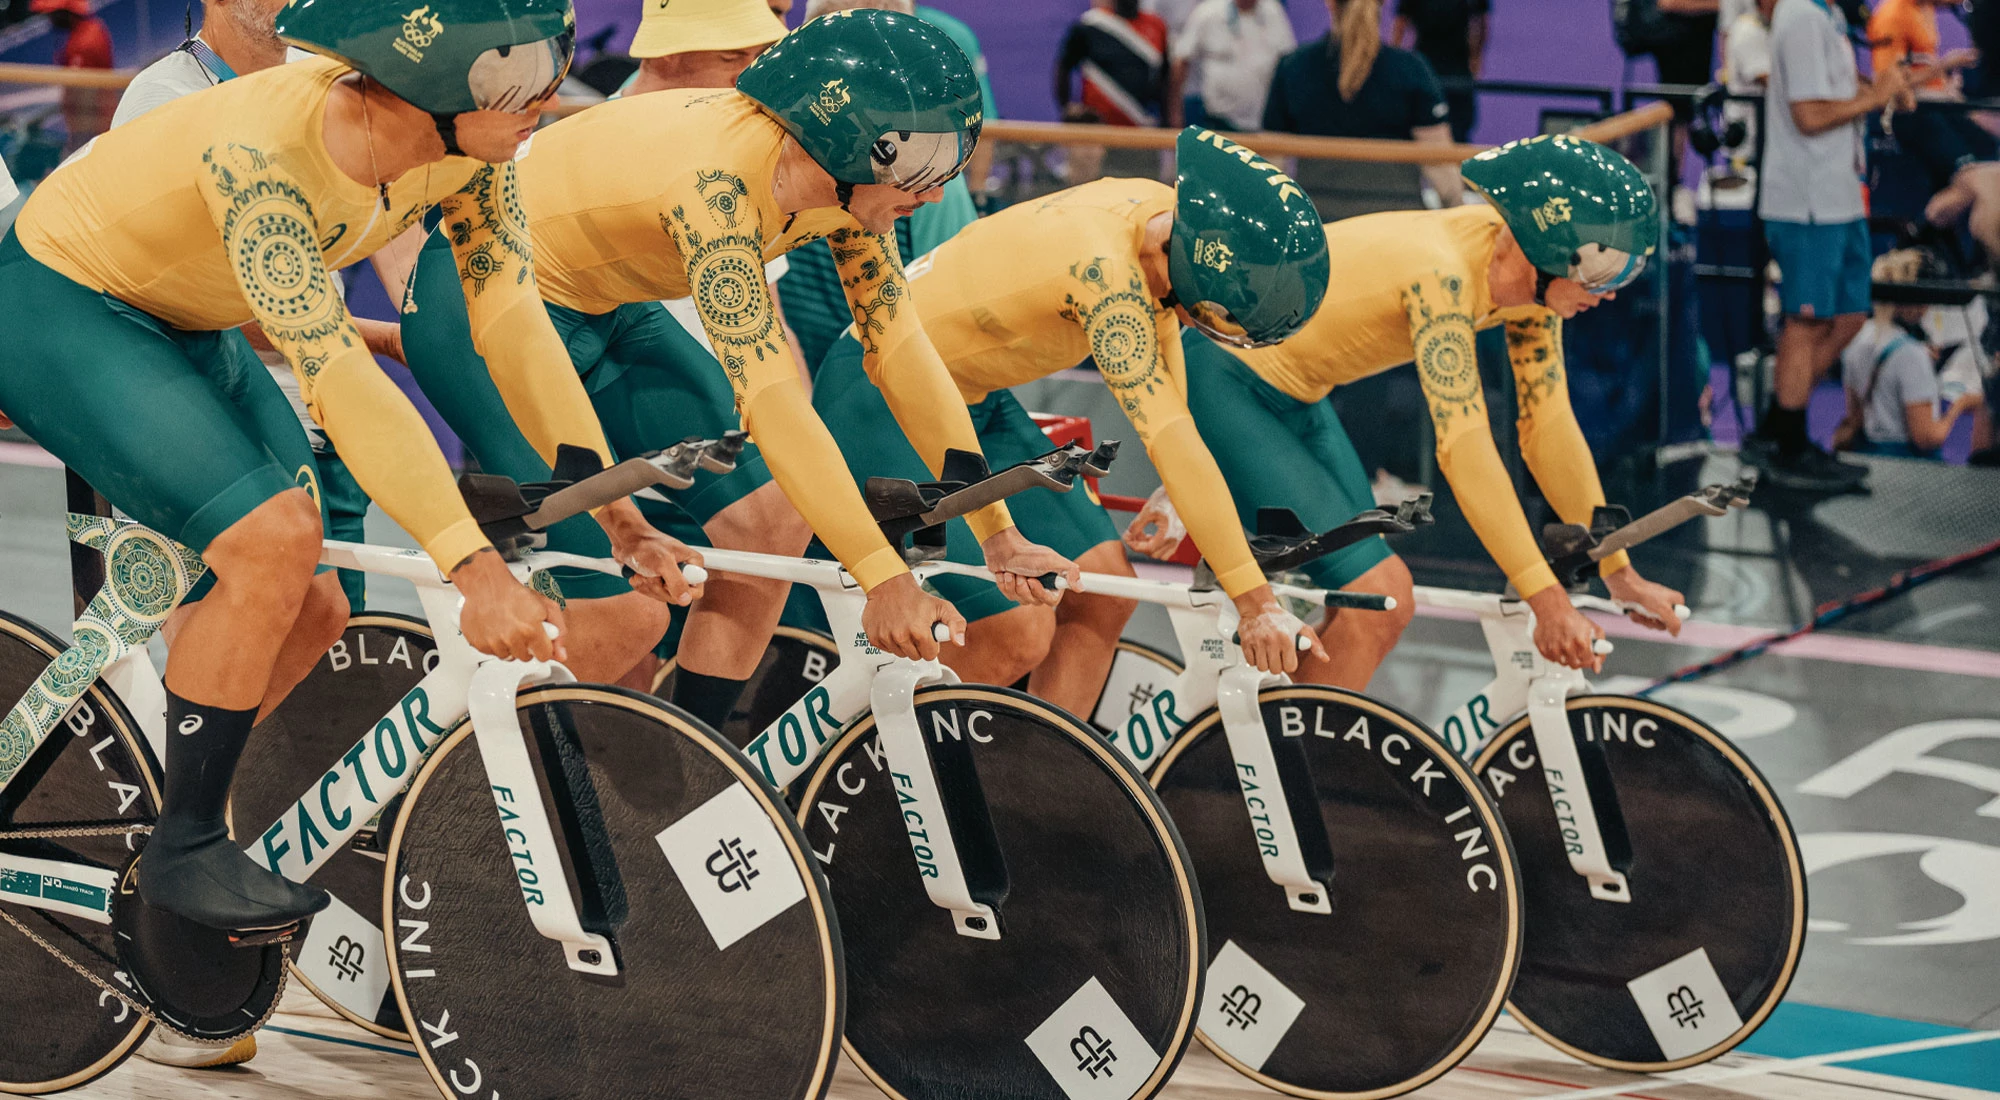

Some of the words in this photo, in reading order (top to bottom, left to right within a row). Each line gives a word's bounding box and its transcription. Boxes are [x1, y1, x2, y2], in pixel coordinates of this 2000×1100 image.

[931, 708, 994, 744] NC
[1583, 712, 1659, 749] INC
[262, 686, 447, 875] FACTOR
[892, 771, 939, 879] FACTOR
[1236, 763, 1279, 858] FACTOR
[1279, 706, 1447, 797] BLACK
[1444, 806, 1497, 893] INC
[1545, 767, 1584, 856] FACTOR
[491, 785, 544, 906] FACTOR
[399, 874, 437, 979] INC
